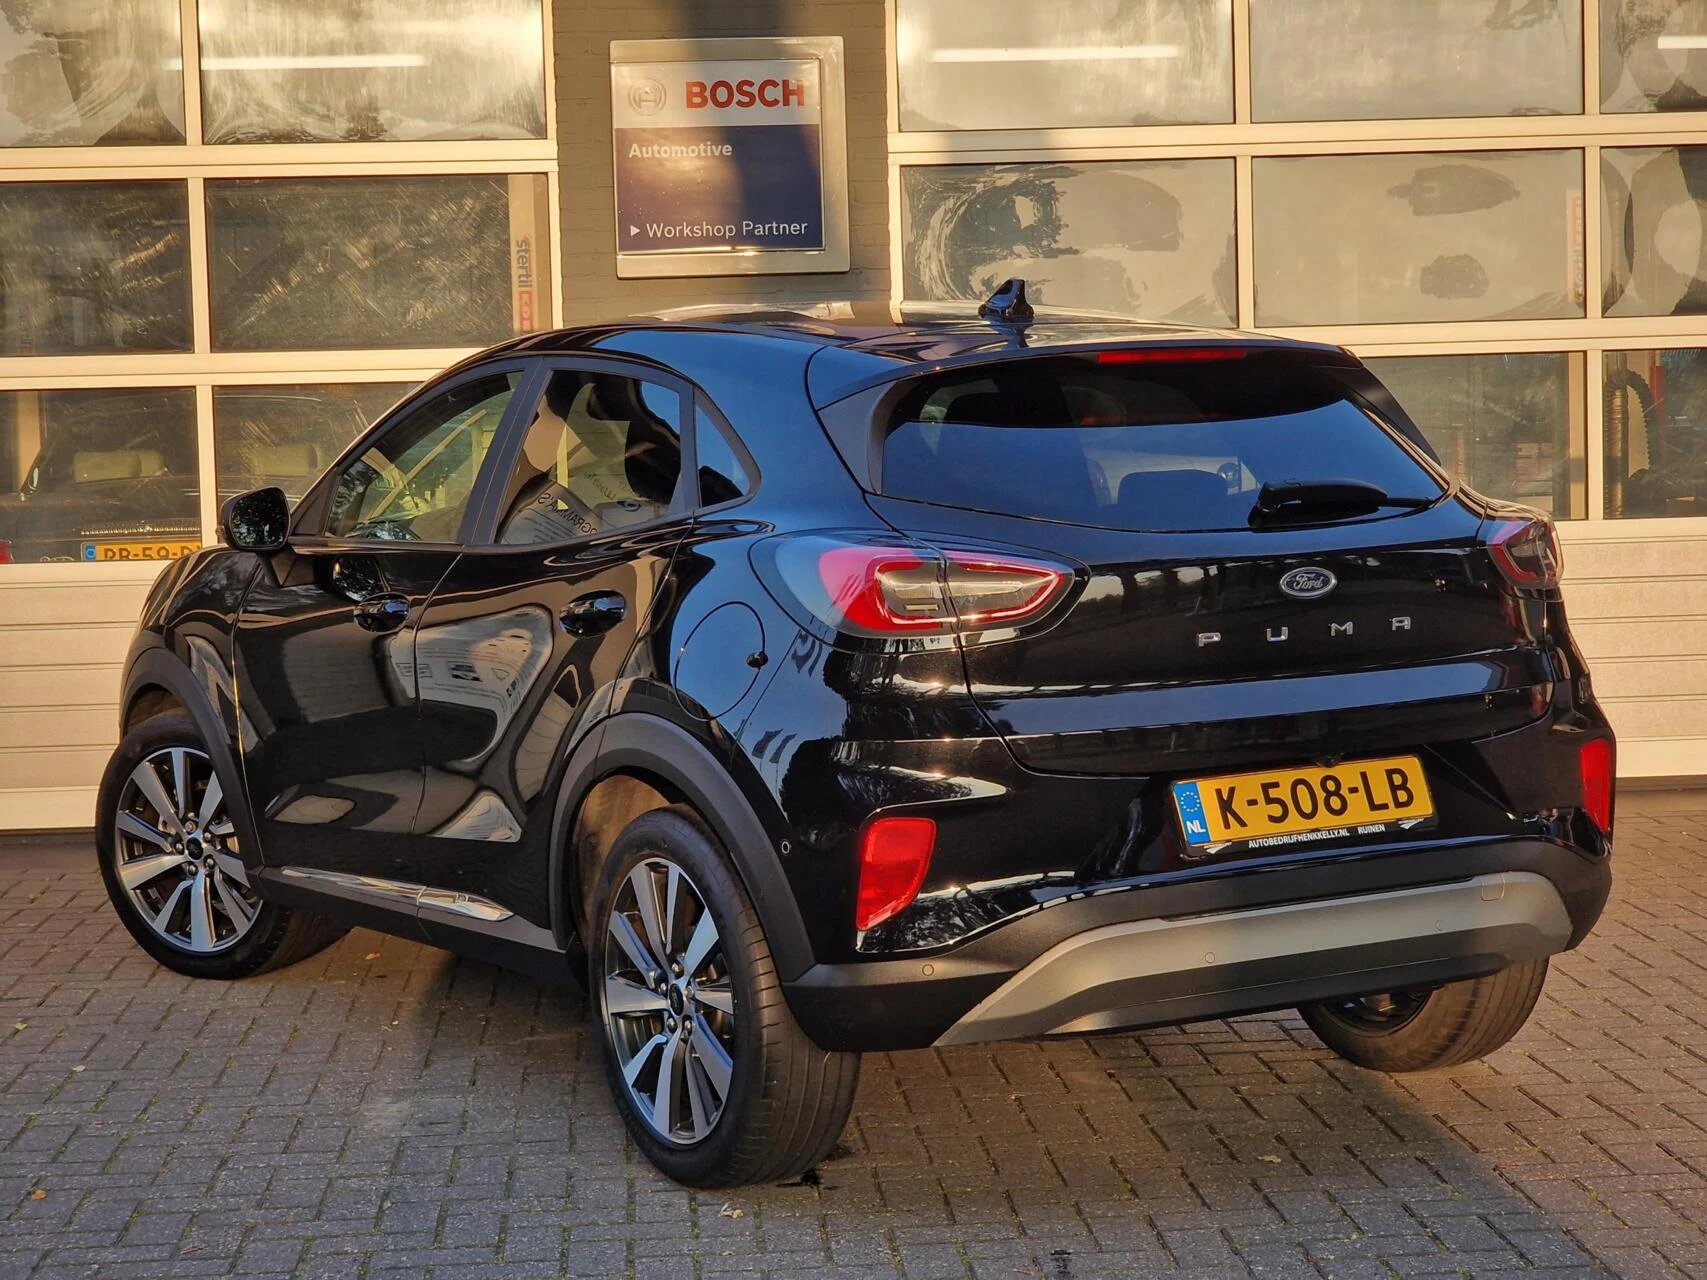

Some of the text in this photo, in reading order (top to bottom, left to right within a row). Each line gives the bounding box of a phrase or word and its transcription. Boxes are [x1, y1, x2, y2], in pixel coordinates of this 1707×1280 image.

[685, 79, 805, 109] BOSCH
[629, 141, 733, 159] Automotive
[646, 220, 809, 239] Workshop Partner
[1293, 573, 1325, 590] Ford
[1198, 616, 1411, 647] PUMA
[1186, 767, 1414, 834] NL K-508-LB
[1248, 824, 1386, 849] AUTOBEDRIJFHENKKELLY.NL RUINEN
